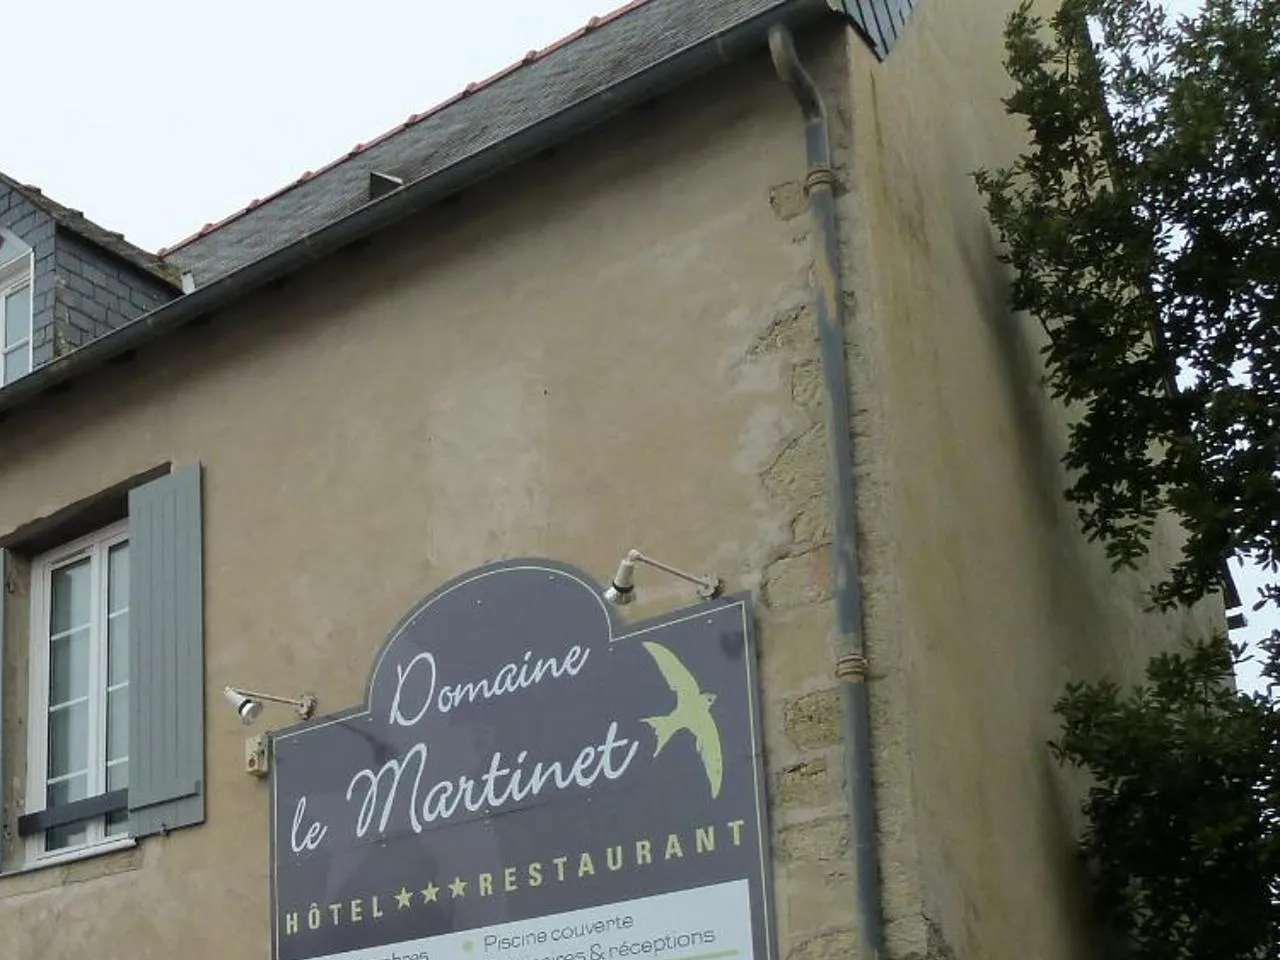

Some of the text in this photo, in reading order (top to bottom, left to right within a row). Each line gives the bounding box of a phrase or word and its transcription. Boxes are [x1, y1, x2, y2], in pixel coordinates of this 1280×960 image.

[389, 644, 590, 727] Domaine
[291, 721, 640, 853] le Martinet
[285, 819, 745, 936] HÔTEL RESTAURANT
[484, 914, 634, 953] Piscine couverte
[608, 927, 716, 959] réceptions
